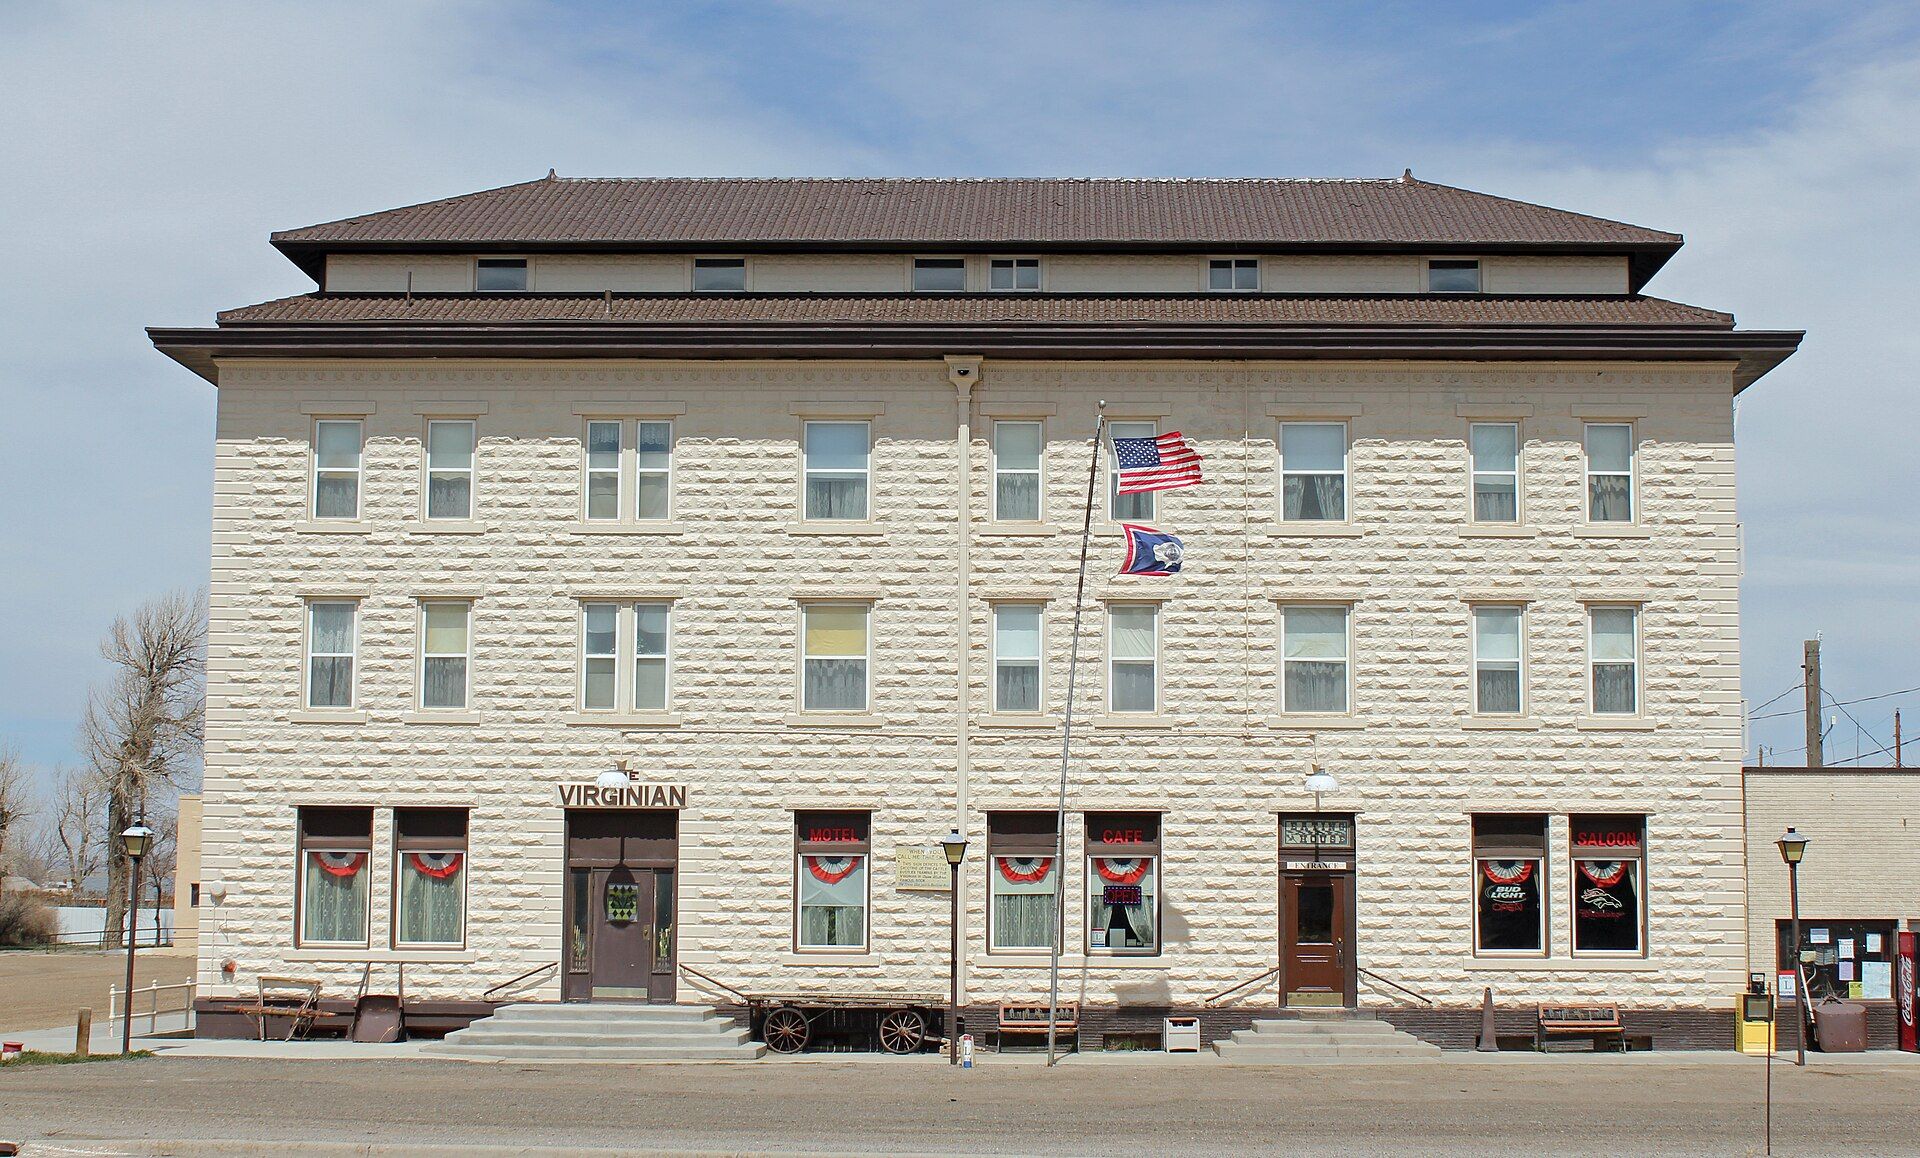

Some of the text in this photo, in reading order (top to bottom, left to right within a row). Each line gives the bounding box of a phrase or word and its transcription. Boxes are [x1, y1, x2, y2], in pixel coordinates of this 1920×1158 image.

[558, 785, 686, 806] VIRGINIAN
[809, 828, 859, 842] MOTEL
[1103, 829, 1143, 845] CAFE
[1577, 832, 1637, 846] SALOON
